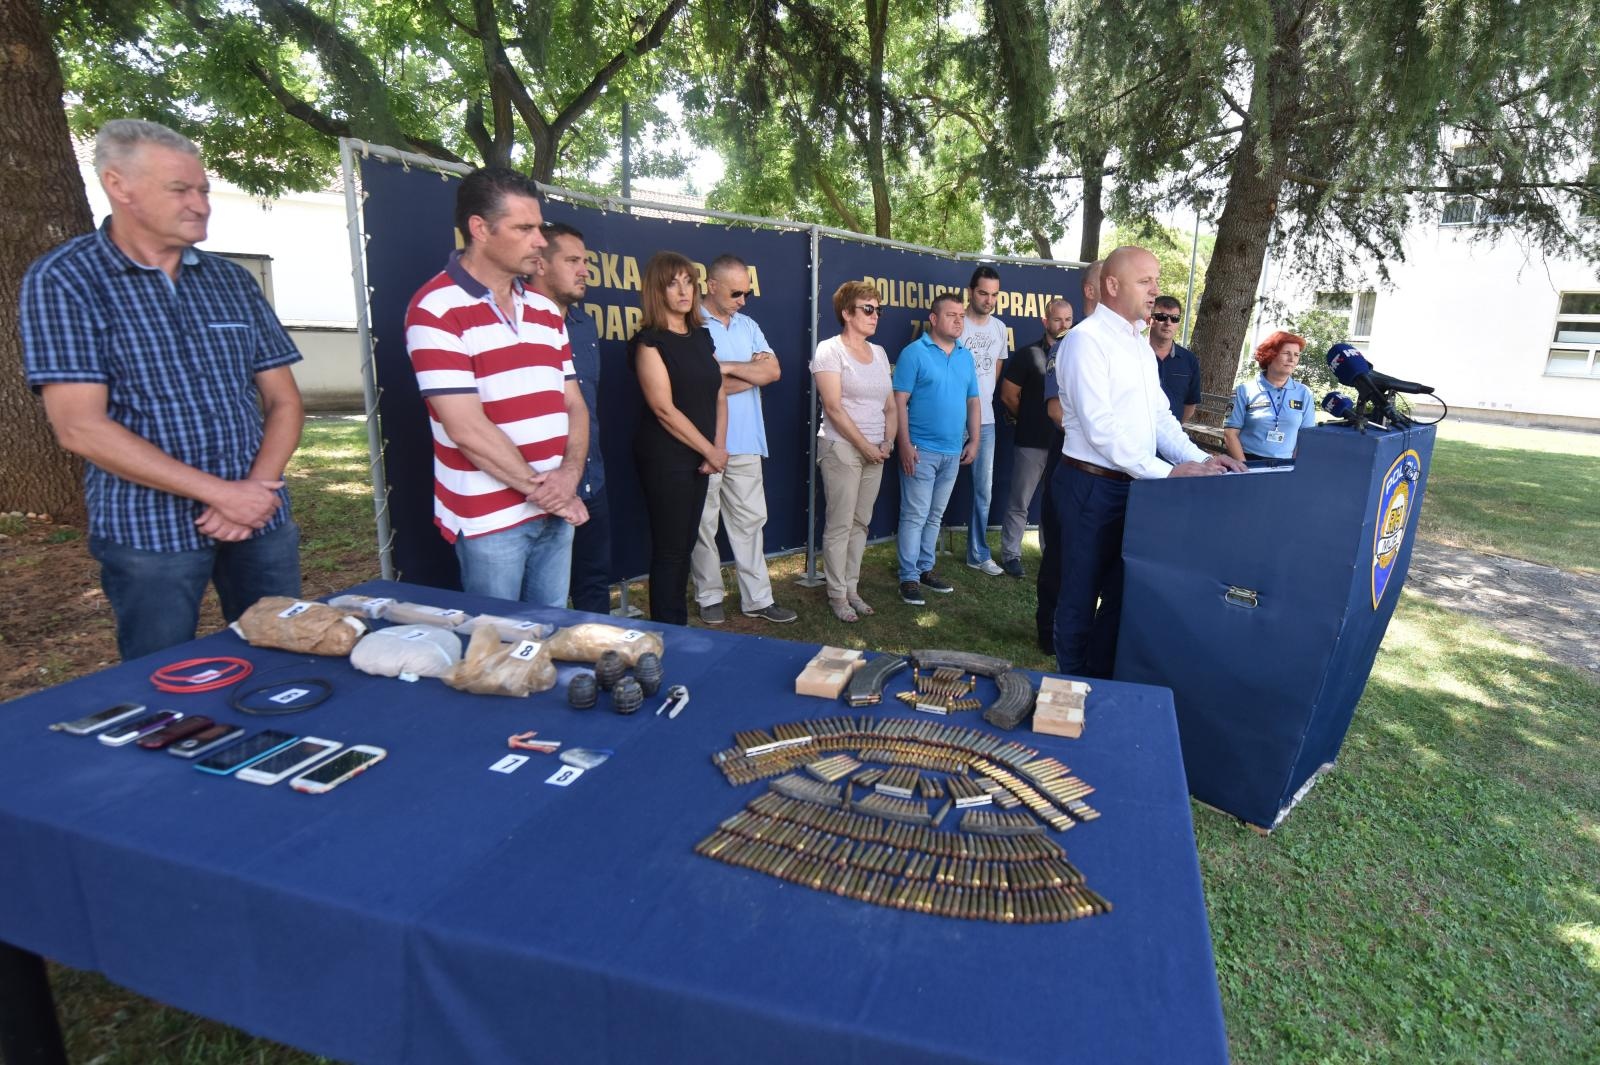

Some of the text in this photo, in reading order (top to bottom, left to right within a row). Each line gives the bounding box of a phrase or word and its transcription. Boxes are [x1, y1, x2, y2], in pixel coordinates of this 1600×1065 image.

[989, 290, 1063, 319] PRAV
[519, 645, 533, 657] 8
[501, 758, 520, 769] 7
[556, 770, 573, 782] 8
